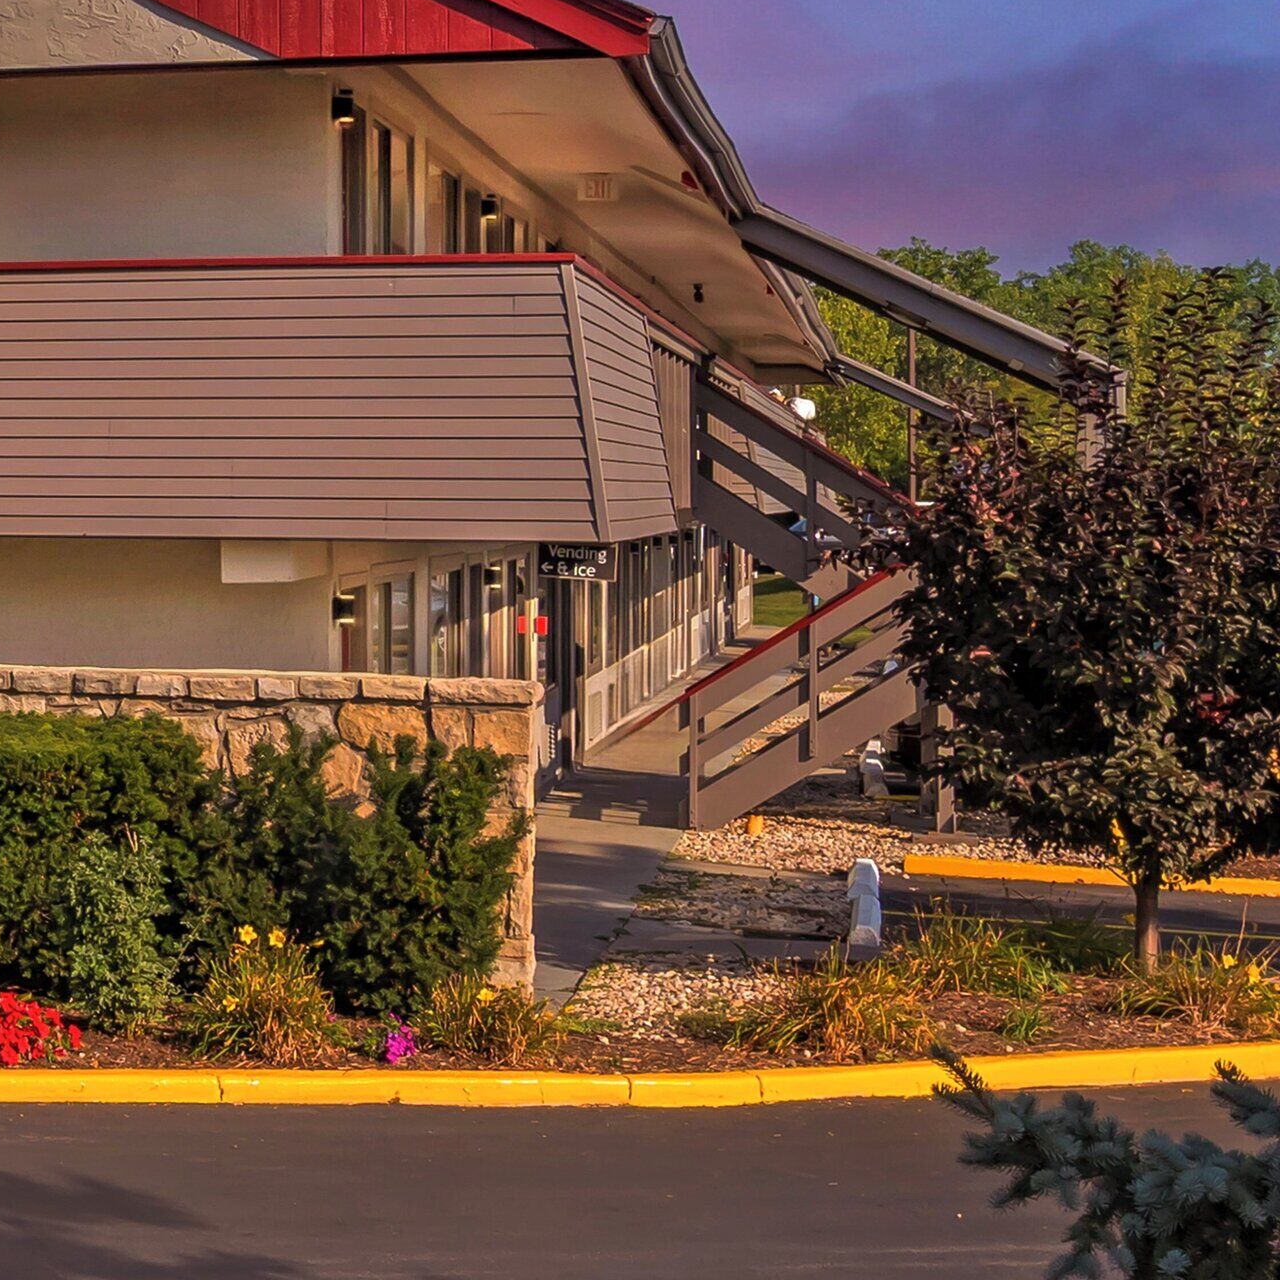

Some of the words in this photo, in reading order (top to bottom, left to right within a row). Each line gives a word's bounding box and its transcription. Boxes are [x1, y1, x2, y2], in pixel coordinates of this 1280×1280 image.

[584, 178, 611, 199] EXIT
[548, 544, 608, 565] Vending
[557, 560, 569, 576] &
